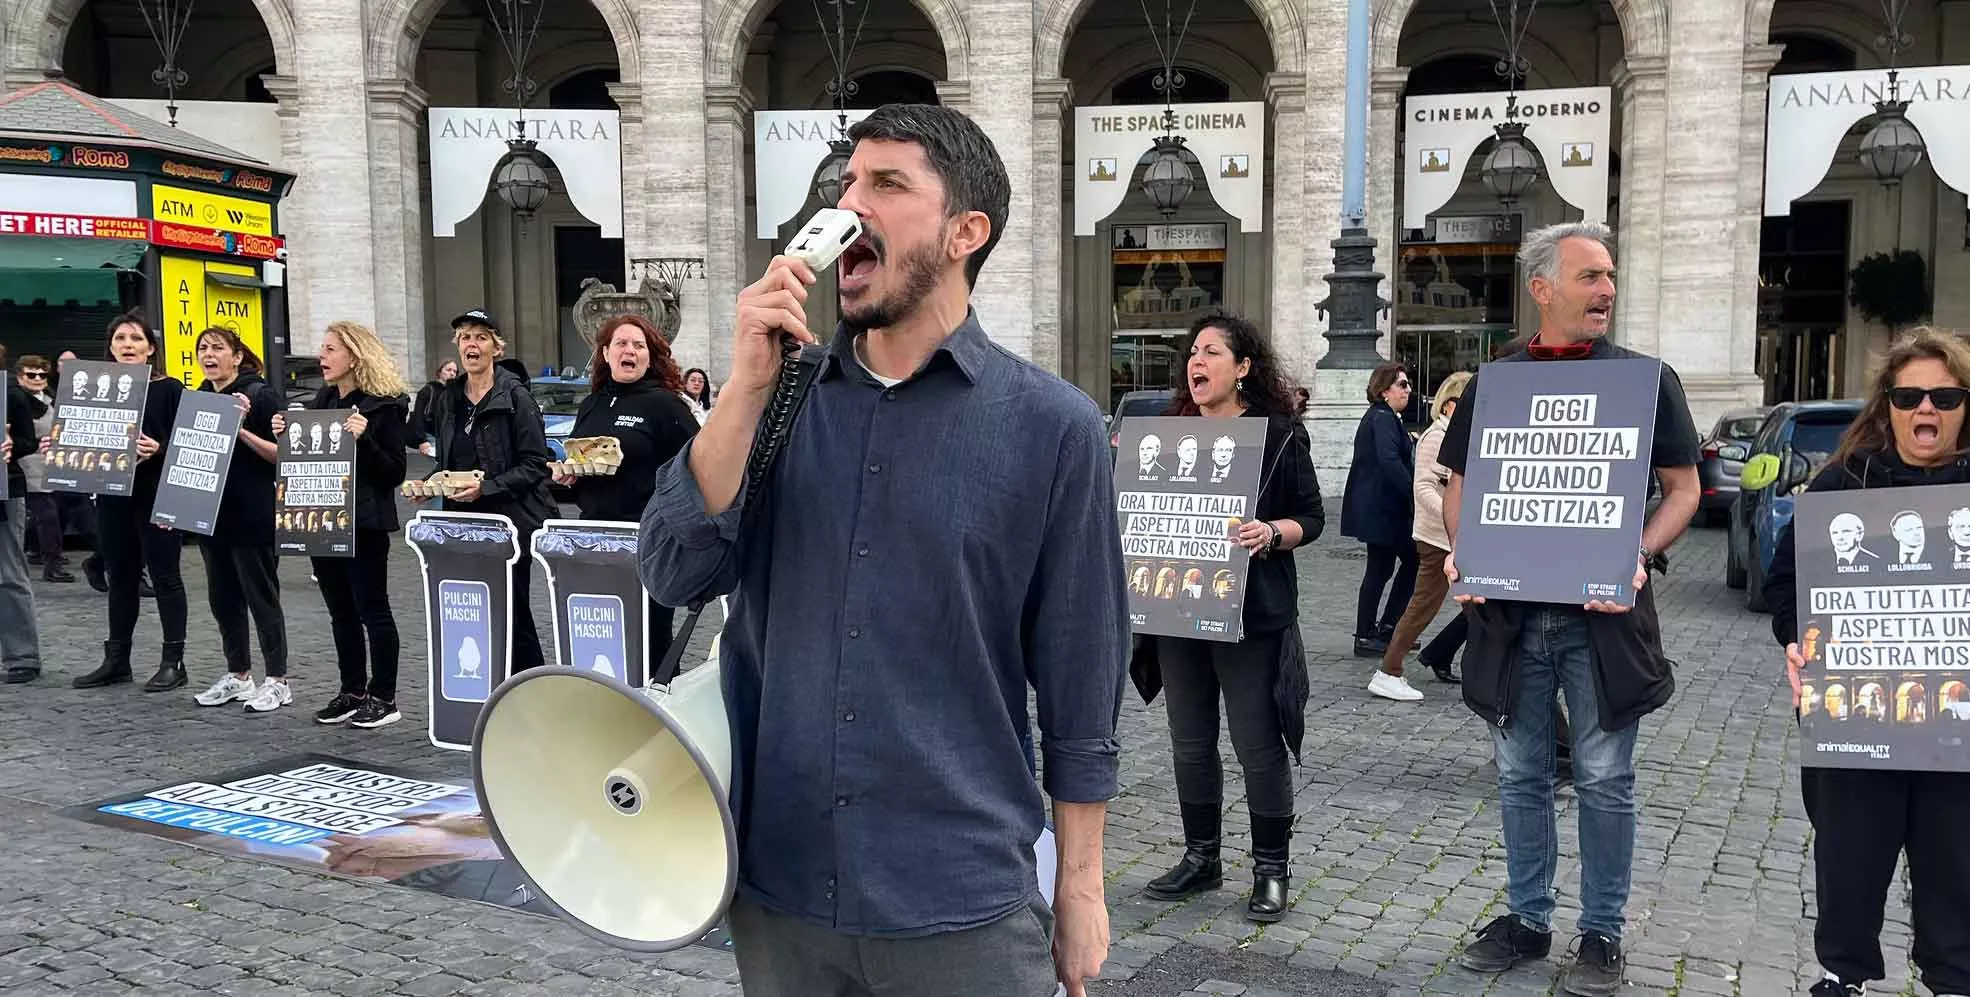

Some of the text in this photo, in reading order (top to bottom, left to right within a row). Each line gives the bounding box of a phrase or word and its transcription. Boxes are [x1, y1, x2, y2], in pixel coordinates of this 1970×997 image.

[1415, 102, 1601, 122] CINEMA MODERNO
[766, 119, 859, 141] ANAN
[1092, 113, 1246, 132] THE SPACE CINEMA
[161, 200, 194, 217] ATM
[0, 214, 146, 236] ET HERE OFFICIAL
[95, 228, 147, 239] RETAILER
[215, 300, 249, 319] ATM
[60, 407, 77, 417] ORA
[81, 408, 107, 419] TUTTA
[1534, 399, 1589, 422] OGGI
[66, 420, 125, 434] ASPETTA UNA
[197, 414, 217, 431] OGGI
[62, 433, 126, 448] VOSTRA MOSSA
[1486, 431, 1631, 459] IMMONDIZIA,
[179, 450, 215, 469] QUANDO
[282, 463, 349, 475] ORA TUTTA ITALIA
[169, 468, 216, 489] GIUSTIZIA?
[290, 478, 340, 490] ASPETTA UNA
[1506, 465, 1603, 491] QUANDO
[286, 493, 343, 505] VOSTRA MOSSA
[1120, 494, 1242, 514] ORA TUTTA ITALIA
[1485, 497, 1616, 525] GIUSTIZIA?
[1130, 516, 1224, 536] ASPETTA UNA
[1123, 537, 1226, 559] VOSTRA MOSSA
[443, 591, 482, 606] PULCINI
[1815, 591, 1856, 610] ORA
[1864, 589, 1934, 609] TUTTA
[444, 607, 480, 622] MASCHI
[573, 606, 615, 622] PULCINI
[574, 623, 613, 639] MASCHI
[1839, 617, 1970, 638] ASPETTA UN
[1831, 645, 1970, 666] VOSTRA MOS
[1816, 741, 1890, 754] animalEQUALITY
[237, 777, 413, 812] DITE STOP
[158, 785, 393, 832] ALLA STRAGE
[108, 800, 333, 846] DEI PULCINI
